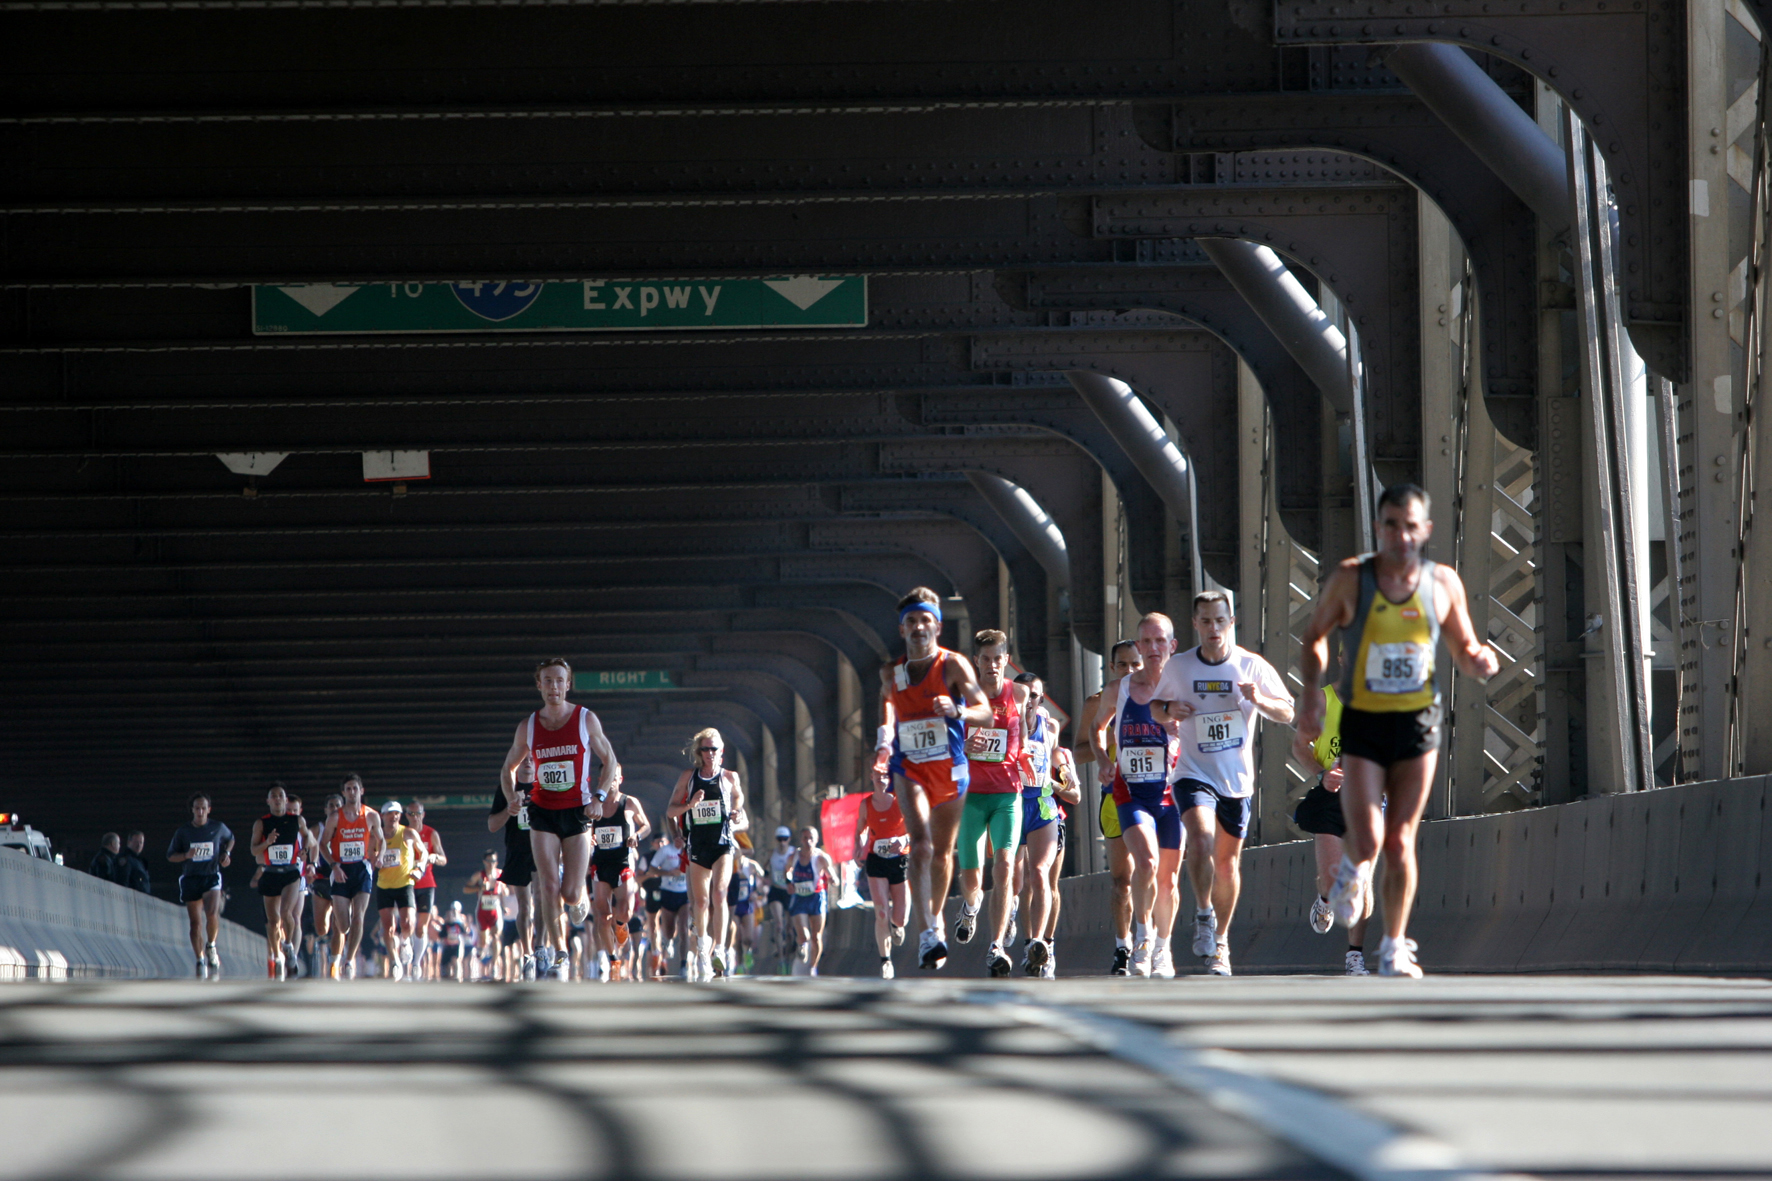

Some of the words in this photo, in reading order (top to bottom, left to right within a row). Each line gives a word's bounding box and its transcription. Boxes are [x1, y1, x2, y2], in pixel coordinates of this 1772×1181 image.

[583, 281, 721, 316] Expwy
[1382, 658, 1413, 678] 985
[600, 672, 647, 684] RIGHT
[1202, 715, 1221, 724] ING
[907, 723, 924, 732] ING
[1122, 723, 1162, 737] FRANCE
[1208, 723, 1230, 741] 461
[913, 730, 936, 748] 179
[535, 744, 578, 759] DANMARK
[1126, 749, 1143, 757] ING
[1130, 757, 1152, 773] 915
[543, 770, 567, 784] 3021
[697, 807, 716, 817] 1085
[601, 833, 615, 844] 987
[275, 850, 288, 859] 160
